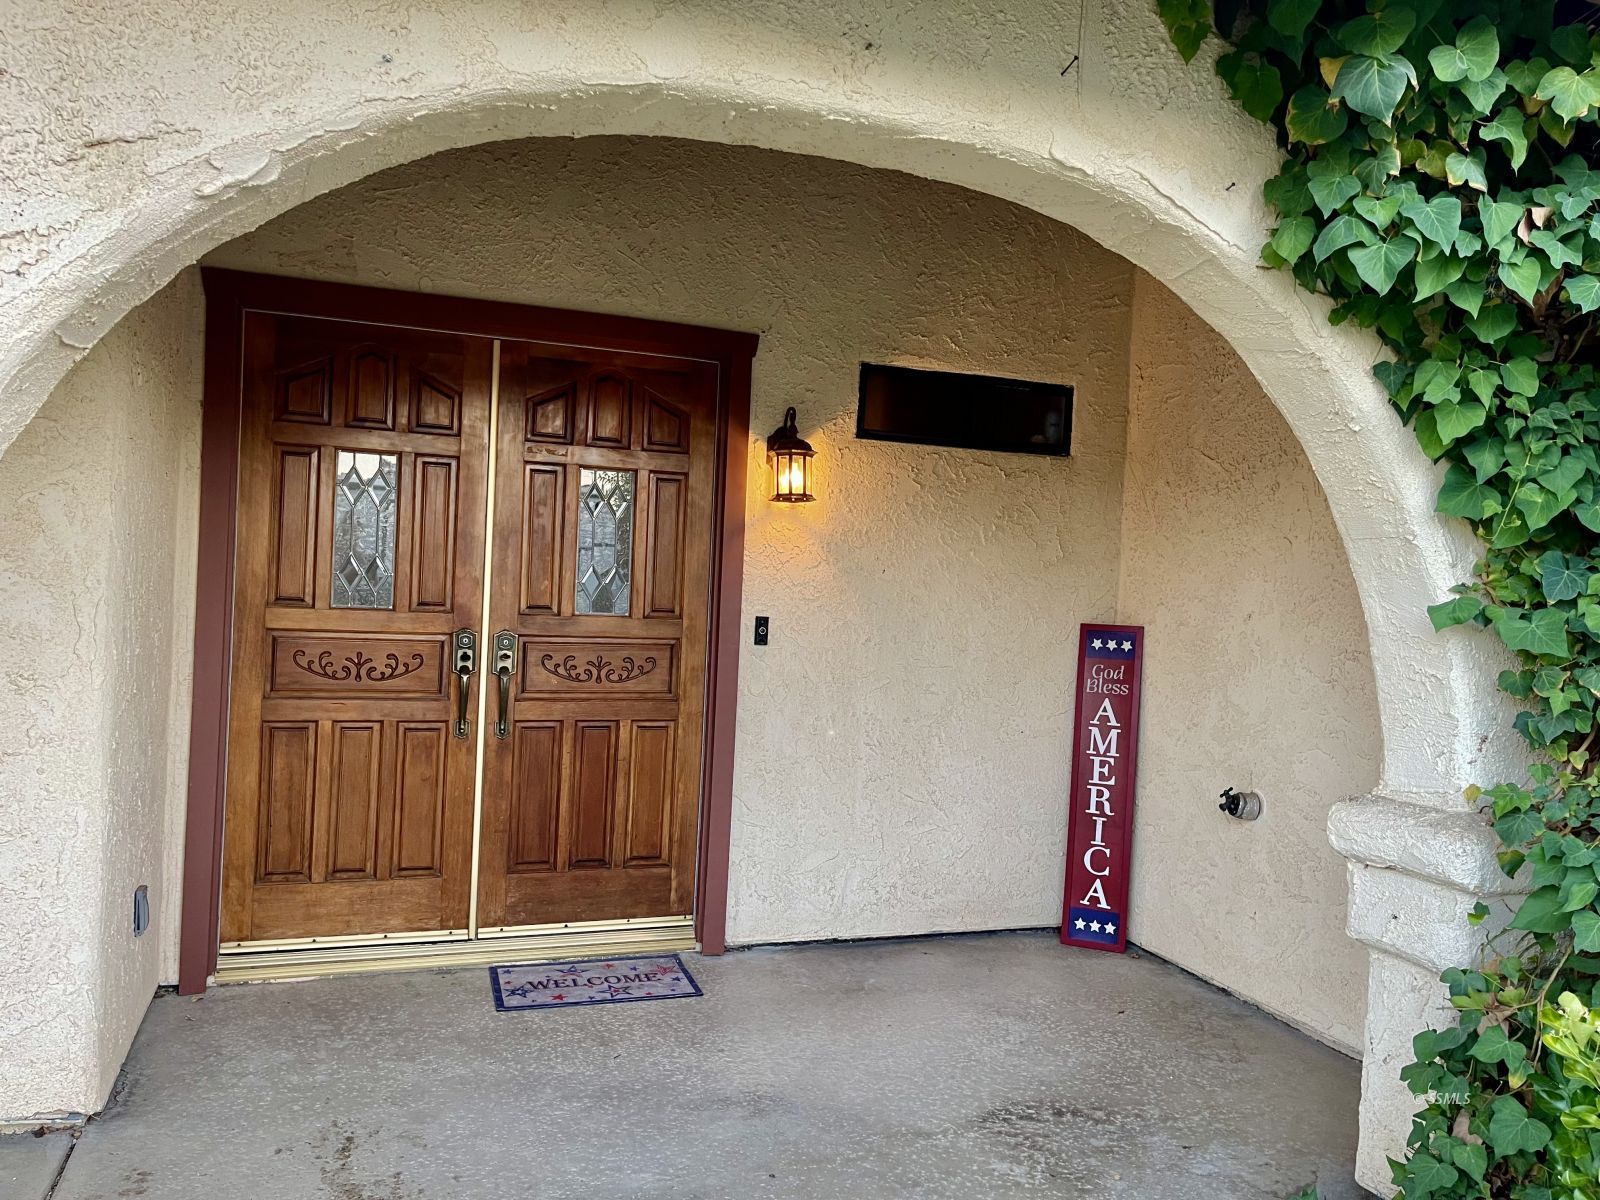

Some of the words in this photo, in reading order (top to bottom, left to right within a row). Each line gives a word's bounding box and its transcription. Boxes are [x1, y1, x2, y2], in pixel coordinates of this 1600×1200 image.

[1092, 664, 1125, 679] God
[1086, 678, 1129, 695] Bless
[1080, 697, 1121, 909] AMERICA
[526, 972, 662, 990] WELCOME
